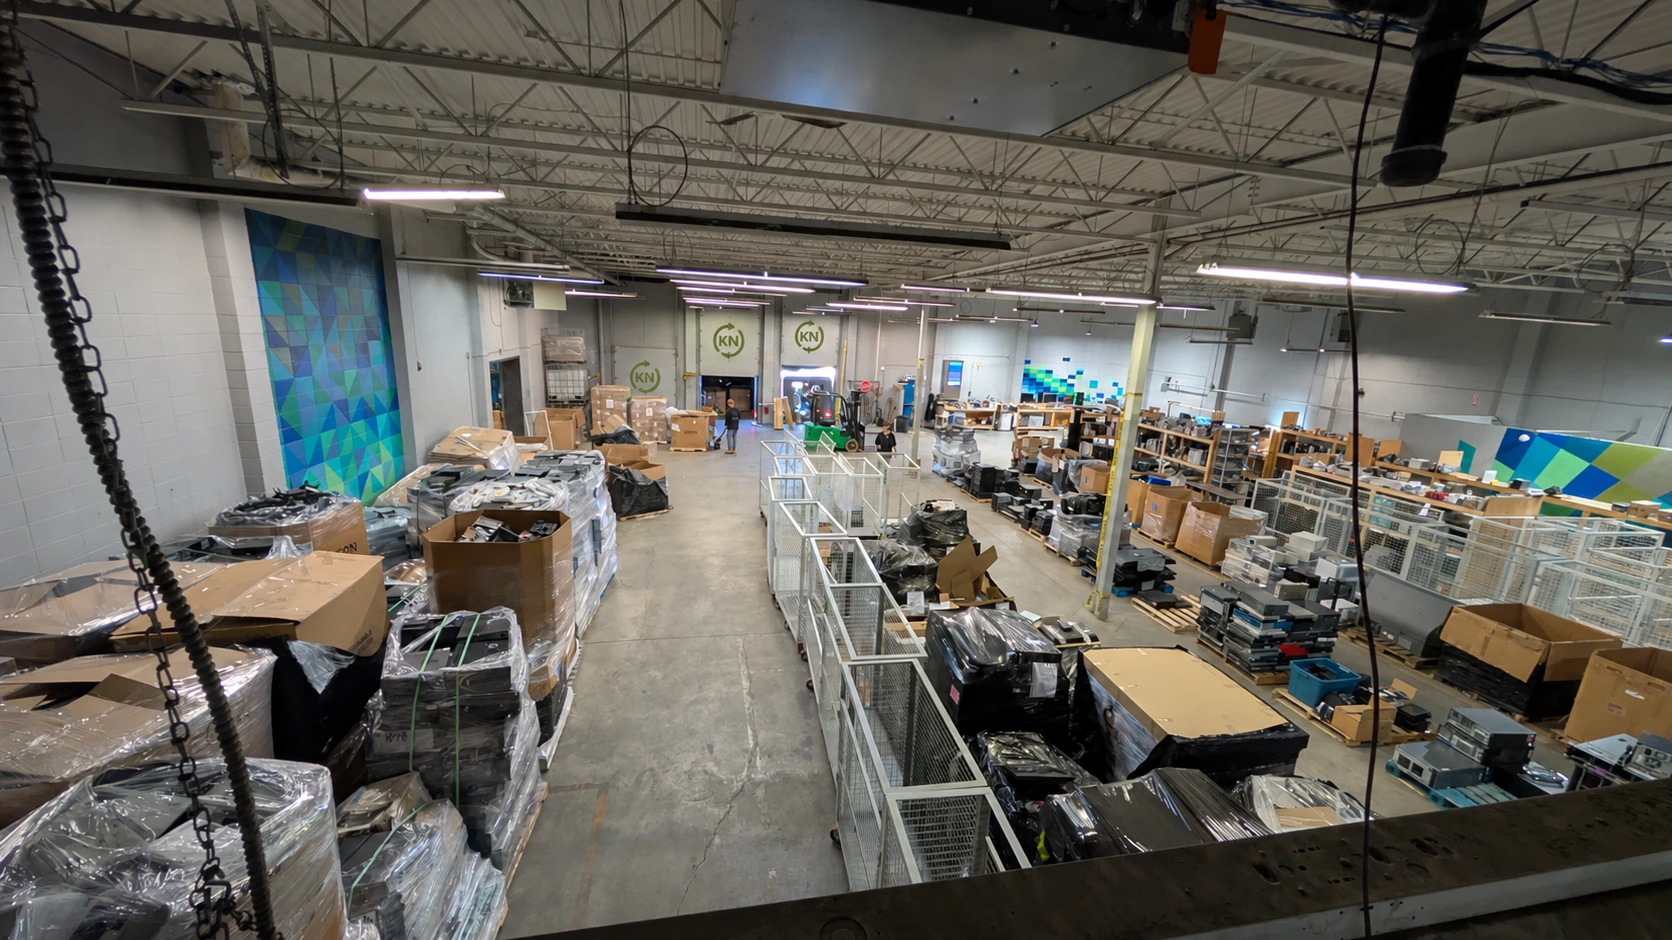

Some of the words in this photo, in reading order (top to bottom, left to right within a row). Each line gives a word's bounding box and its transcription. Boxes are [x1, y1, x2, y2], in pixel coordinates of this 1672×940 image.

[719, 335, 739, 347] KN
[800, 331, 819, 342] KN
[635, 372, 655, 383] KN
